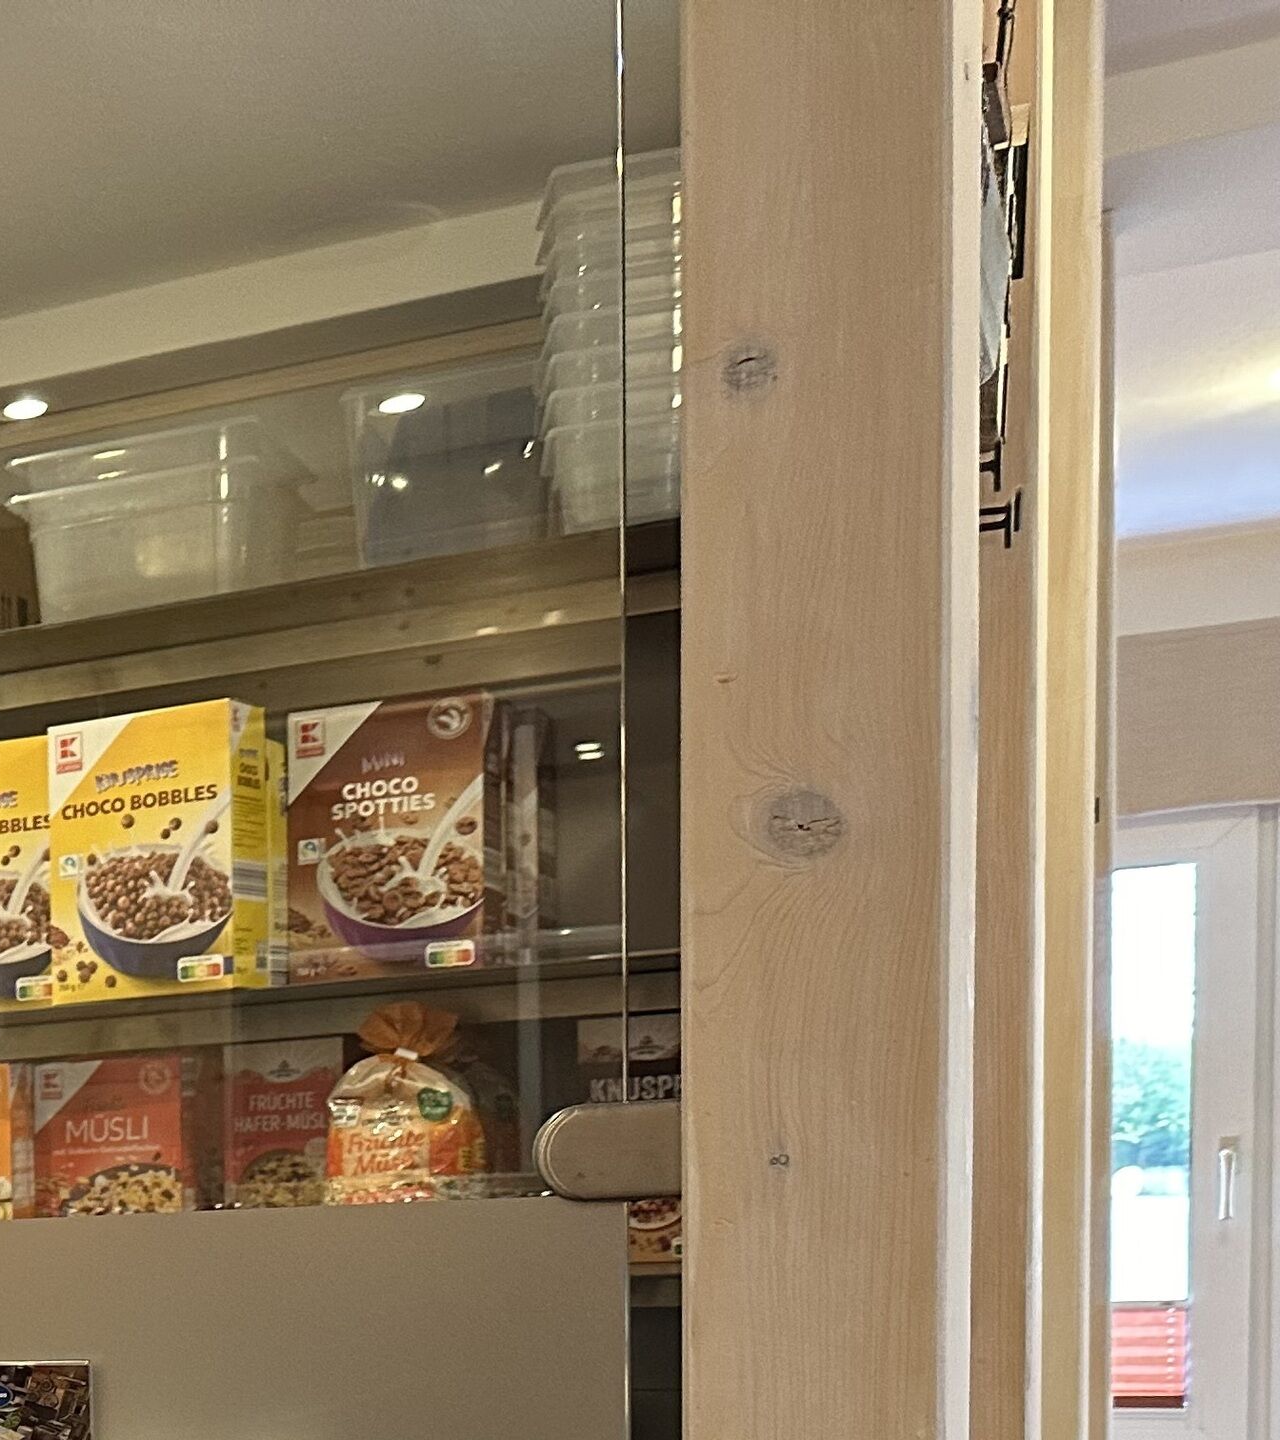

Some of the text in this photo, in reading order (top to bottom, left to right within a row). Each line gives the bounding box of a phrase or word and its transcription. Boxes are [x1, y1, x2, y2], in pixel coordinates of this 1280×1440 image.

[62, 784, 218, 821] CHOCO BOBBLES
[342, 776, 419, 801] CHOCO
[331, 793, 436, 820] SPOTTIES
[65, 1113, 149, 1143] MÜSLI
